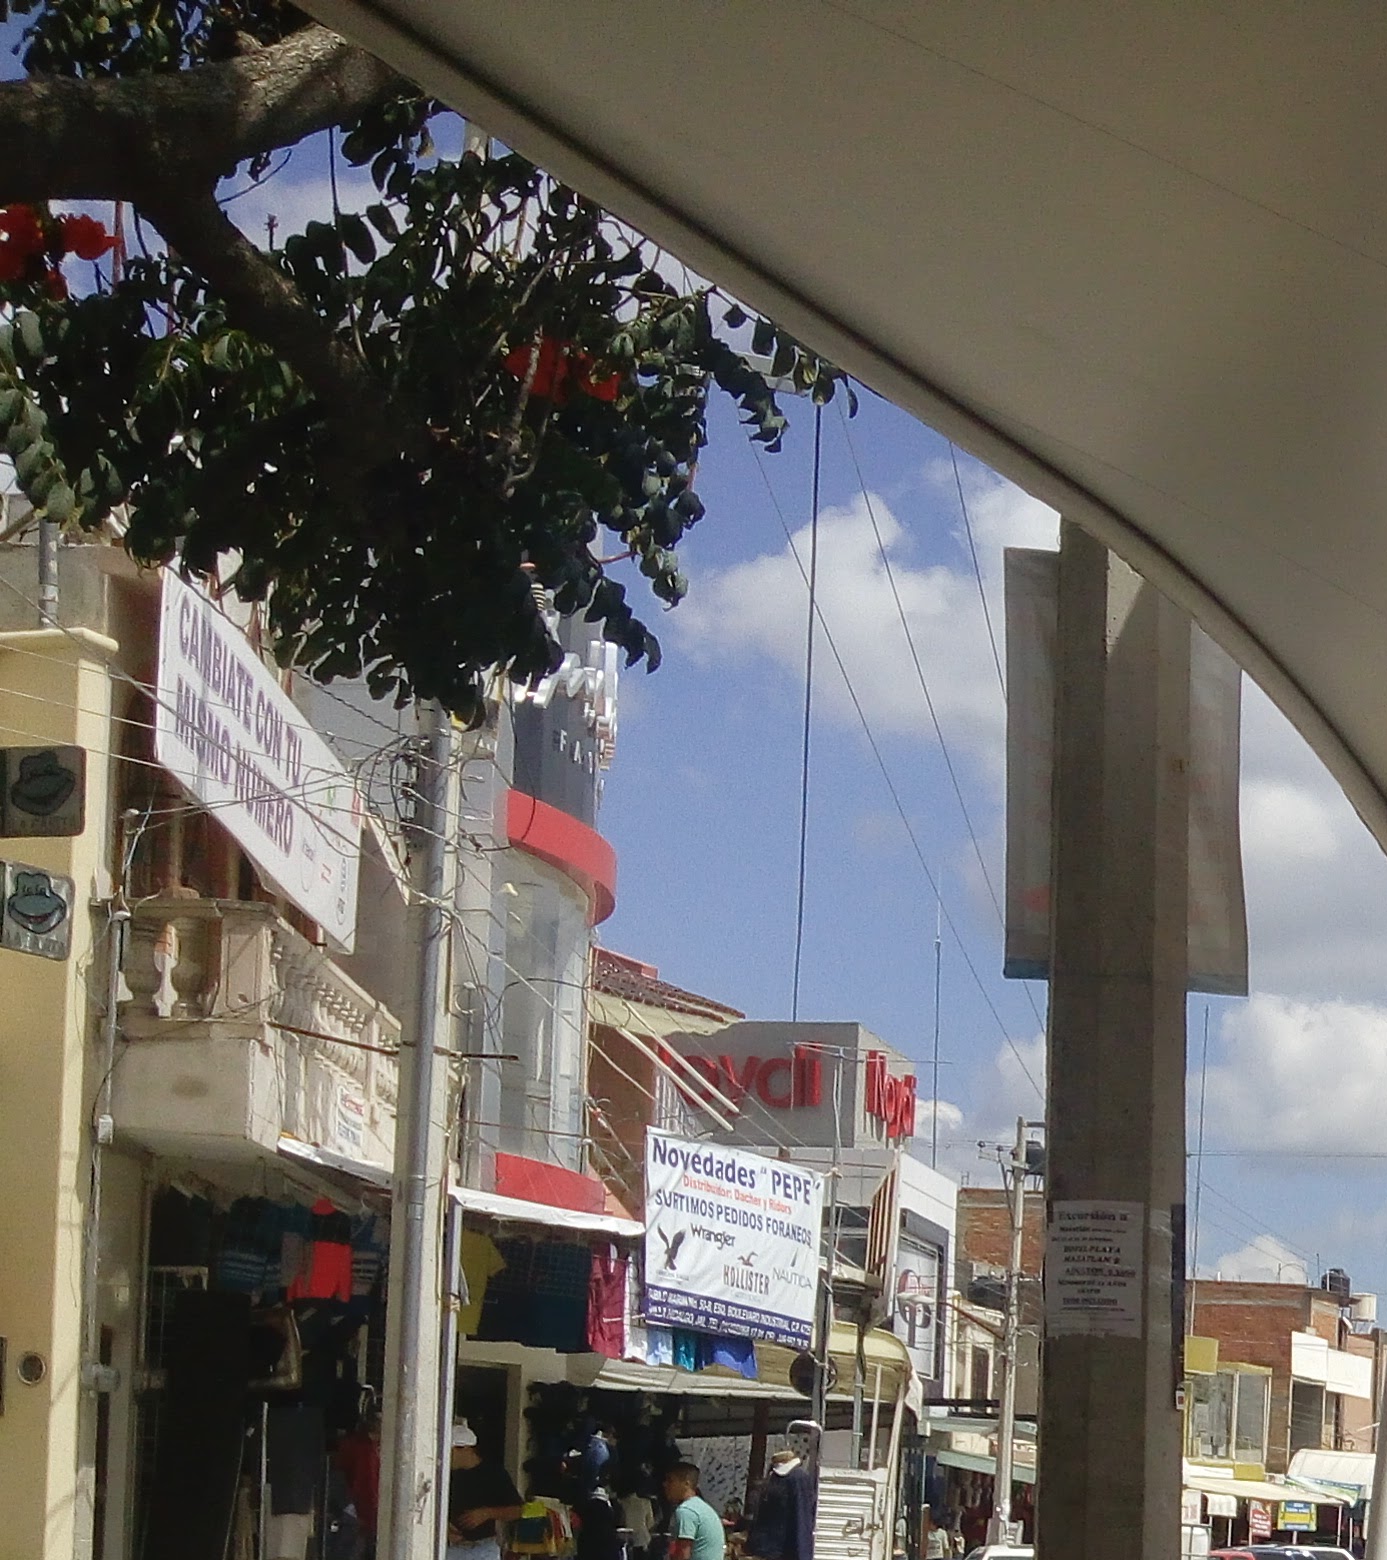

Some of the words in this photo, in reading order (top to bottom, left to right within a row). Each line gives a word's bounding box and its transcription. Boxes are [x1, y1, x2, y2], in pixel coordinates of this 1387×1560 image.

[179, 597, 254, 736] CAMBIATE
[255, 686, 284, 770] CON
[284, 722, 304, 788] TU
[175, 672, 231, 788] MISMO
[652, 1137, 756, 1190] Novedades
[655, 1188, 714, 1220] SURTIMOS
[716, 1204, 763, 1232] PEDIDOS
[690, 1222, 736, 1251] Wrangler
[723, 1264, 770, 1296] HOLLISTER
[772, 1266, 813, 1290] NAUTICA
